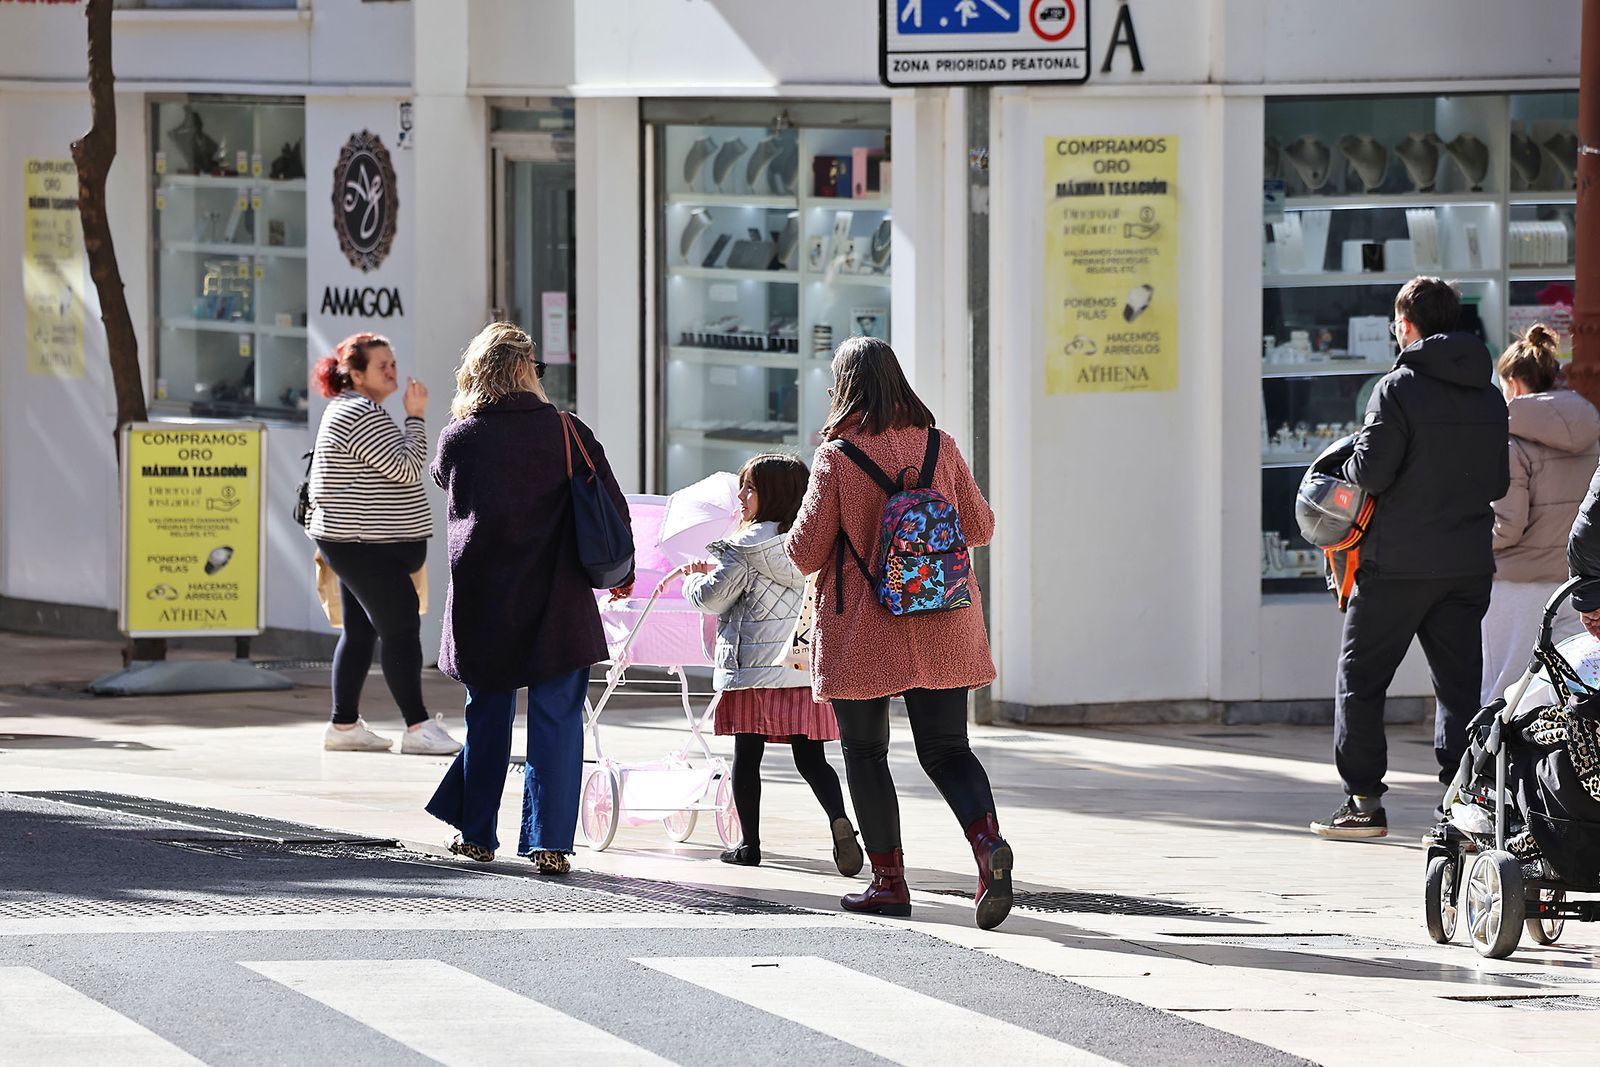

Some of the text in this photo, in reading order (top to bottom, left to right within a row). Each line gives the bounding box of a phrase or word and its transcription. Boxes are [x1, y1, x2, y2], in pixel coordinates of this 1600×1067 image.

[1100, 3, 1145, 72] A
[893, 57, 1080, 72] ZONA PRIORIDAD PEATONAL
[1056, 139, 1167, 155] COMPRAMOS
[1093, 159, 1131, 174] ORO
[1056, 177, 1168, 198] MÁXIMA TASACIÓN
[320, 286, 404, 317] AMAGOA
[1063, 297, 1117, 308] PONEMOS
[1076, 310, 1107, 321] PILAS
[1106, 332, 1160, 343] HACEMOS
[1103, 345, 1161, 355] ARREGLOS
[1077, 363, 1149, 383] ATHENA
[142, 433, 247, 446] COMPRAMOS
[178, 449, 213, 461] ORO
[142, 463, 247, 477] MÁXIMA TASACIÓN
[147, 555, 198, 564] PONEMOS
[159, 564, 189, 573] PILAS
[188, 583, 239, 591] HACEMOS
[185, 592, 239, 601] ARREGLOS
[158, 608, 228, 622] ATHENA
